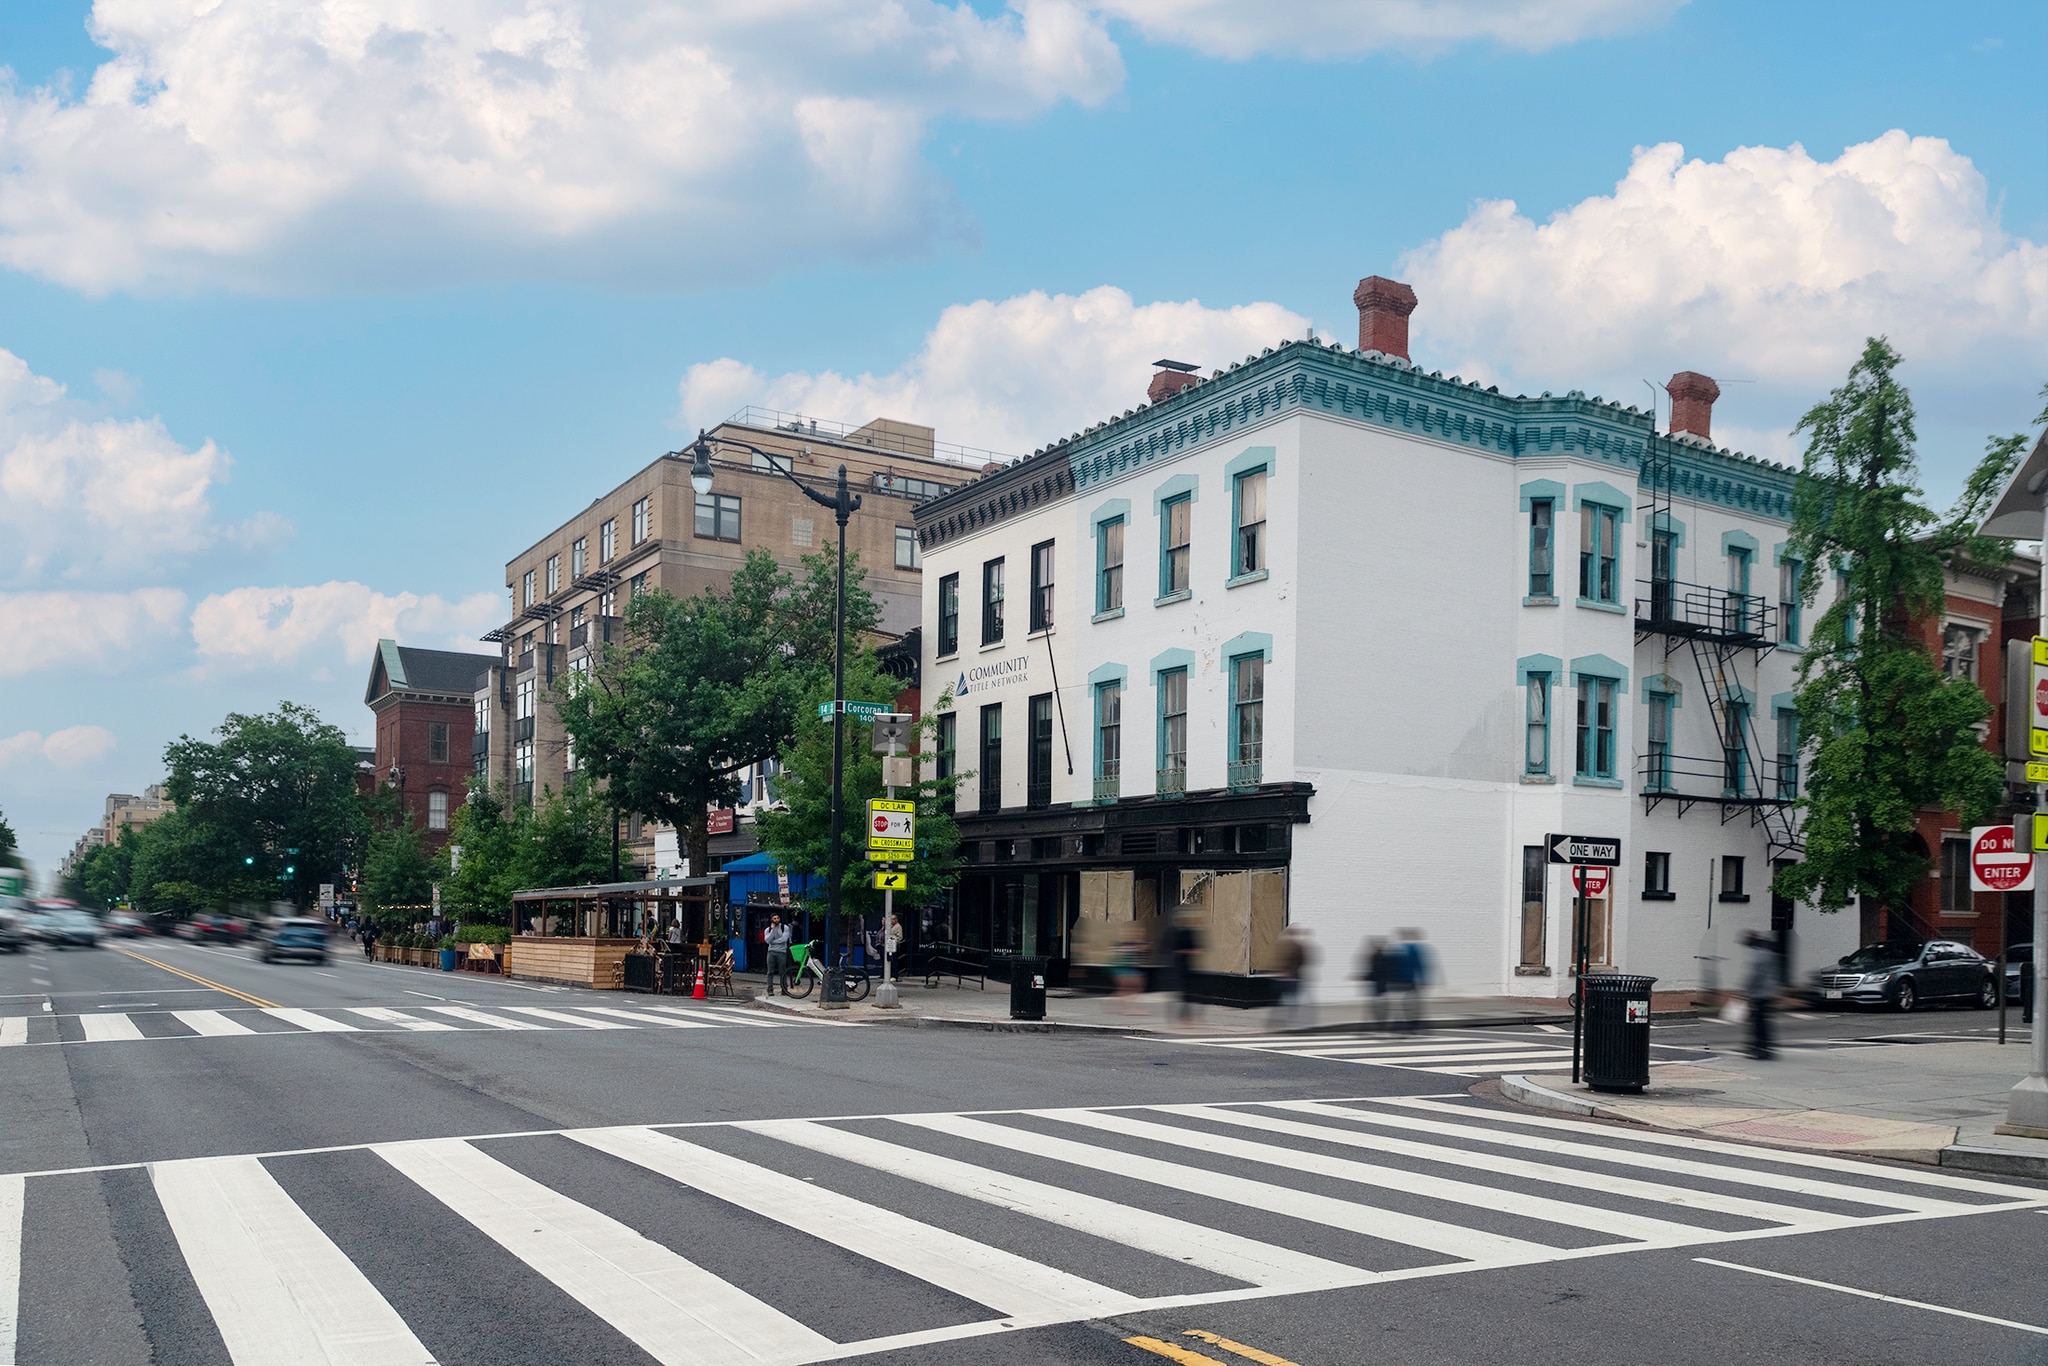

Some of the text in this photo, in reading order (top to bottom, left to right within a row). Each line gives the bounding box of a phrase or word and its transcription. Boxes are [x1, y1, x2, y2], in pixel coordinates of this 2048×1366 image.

[969, 655, 1029, 681] COMMUNITY
[970, 672, 1028, 693] TITLE NETWORK
[847, 702, 882, 714] Corcoran
[881, 839, 911, 847] CROSSWALKS
[1980, 839, 1997, 850] DO
[1570, 843, 1613, 857] ONE WAY
[1984, 867, 2021, 878] ENTER
